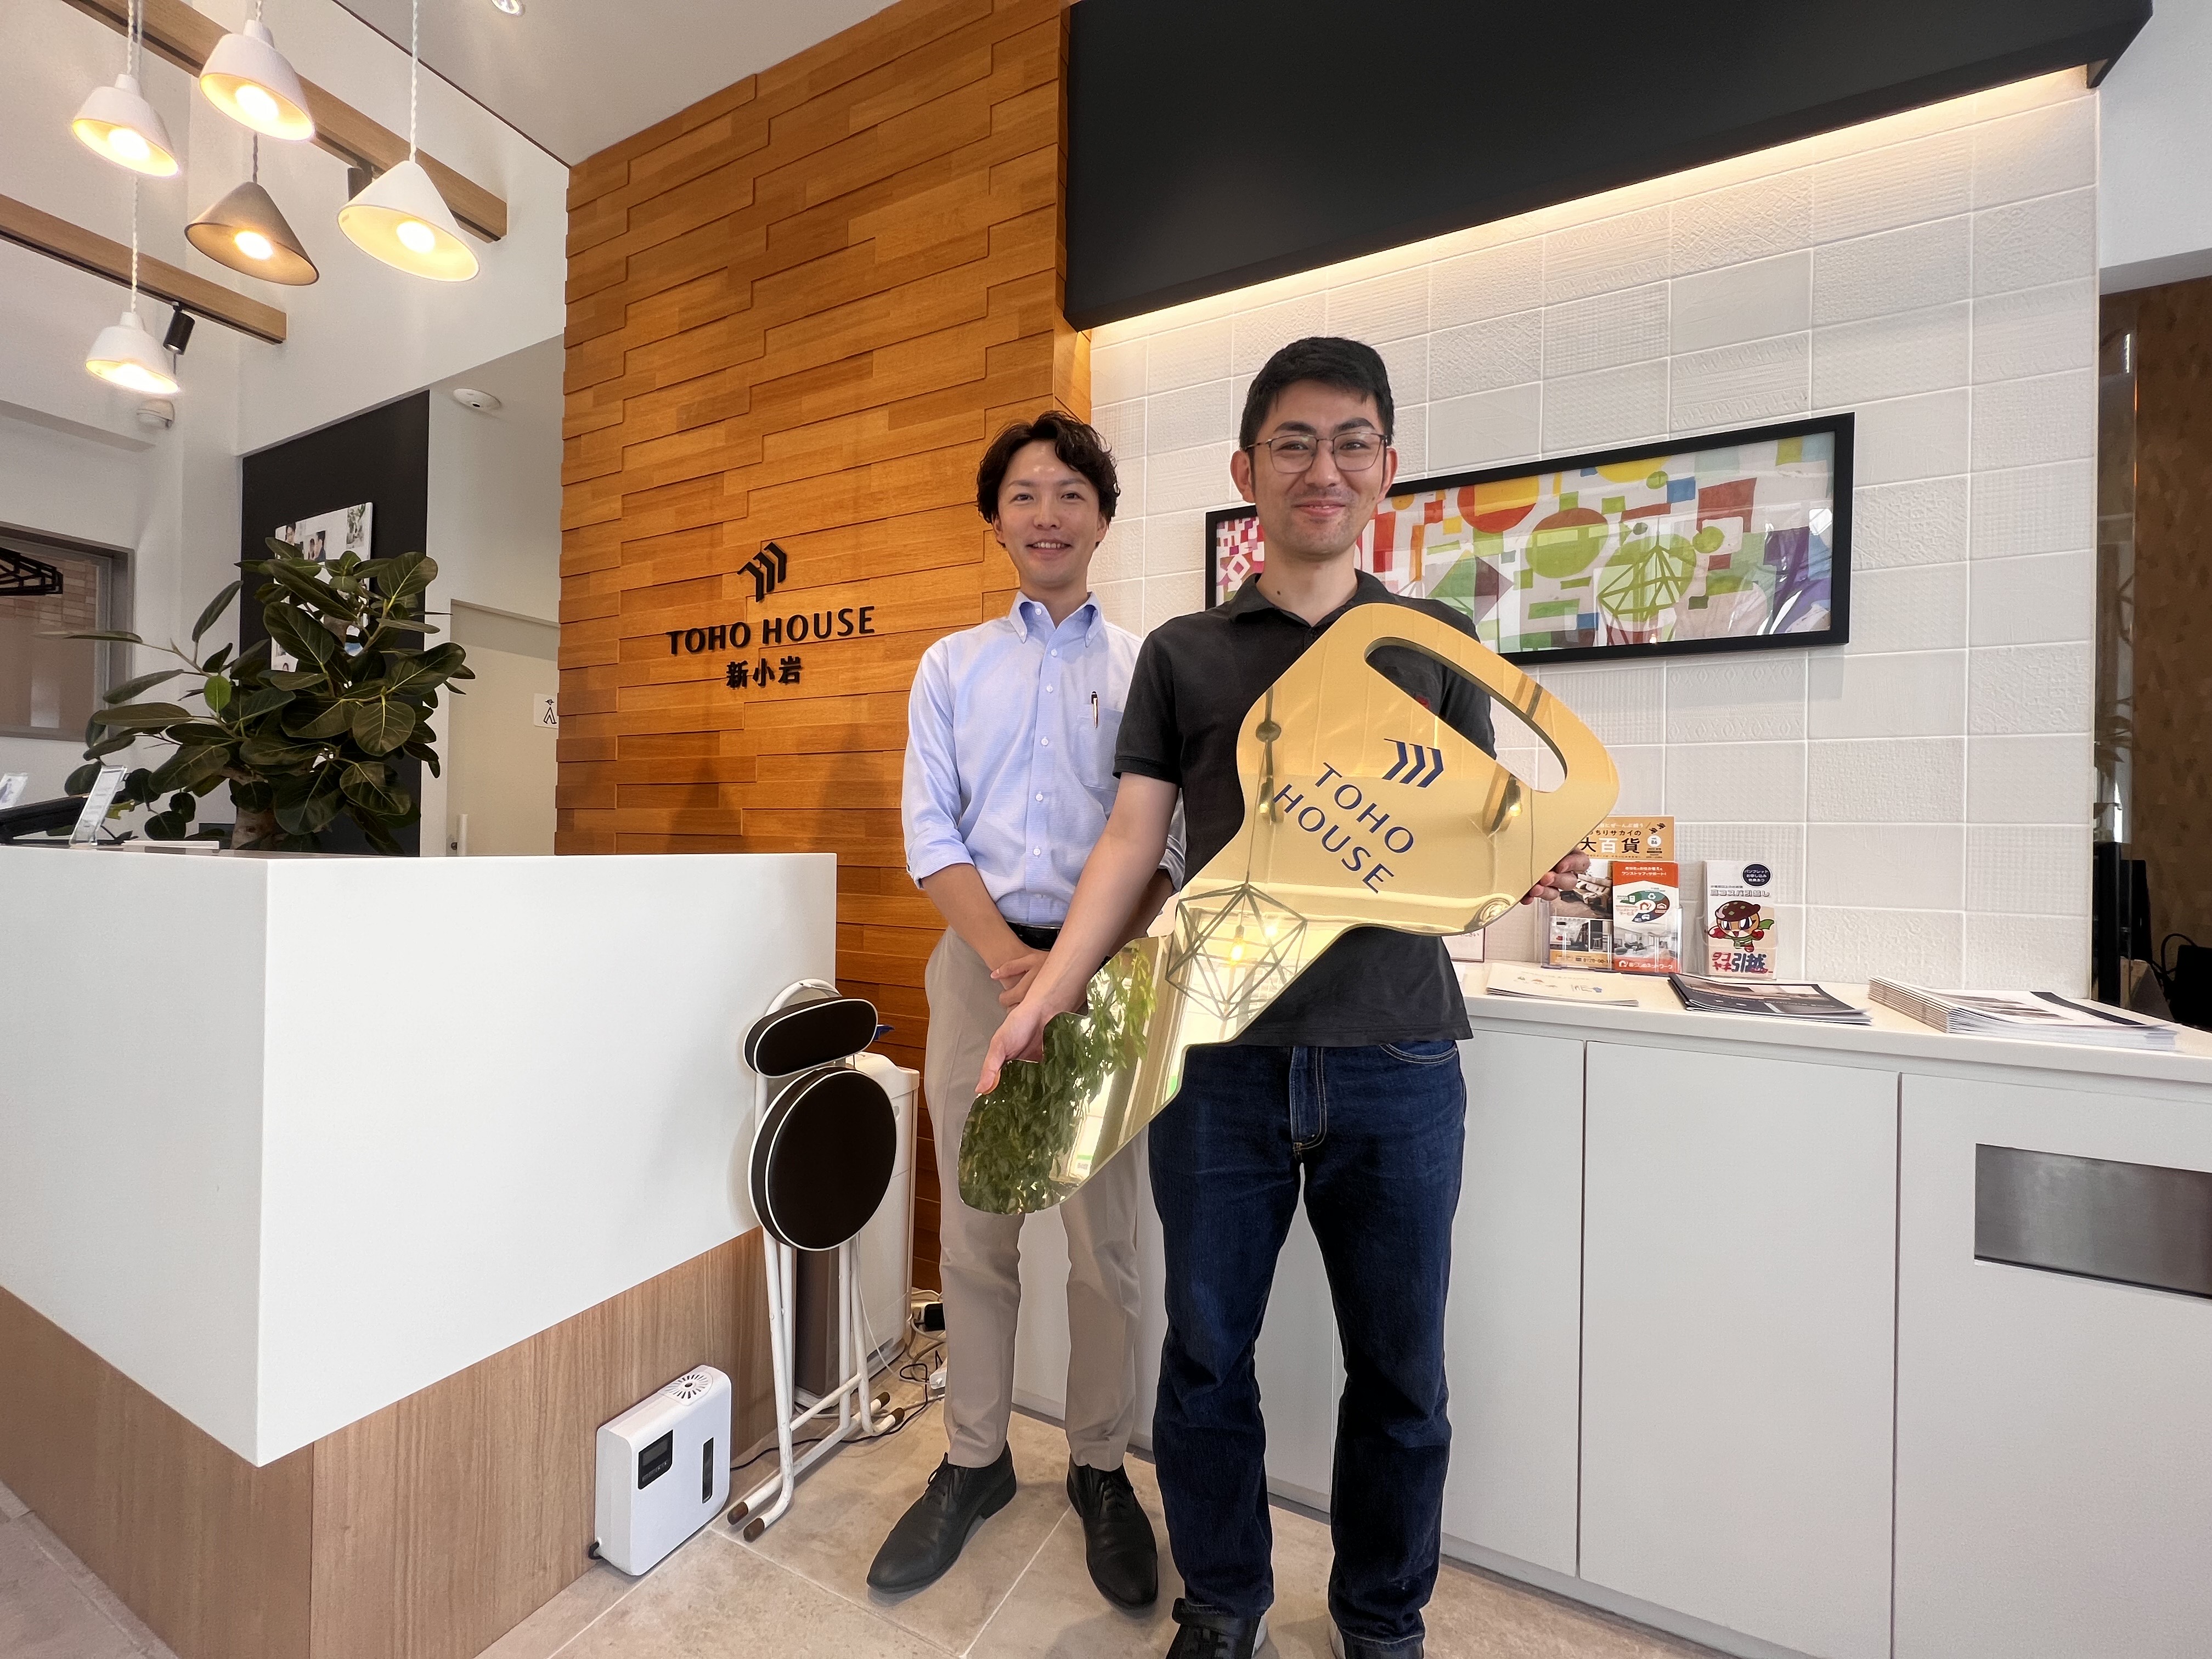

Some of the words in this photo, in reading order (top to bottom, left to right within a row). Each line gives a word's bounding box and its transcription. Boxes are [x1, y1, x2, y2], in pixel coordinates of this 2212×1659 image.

[666, 622, 751, 656] TOHO
[762, 606, 875, 645] HOUSE
[726, 656, 803, 689] 新小岩
[1314, 762, 1414, 854] TOHO
[1273, 783, 1395, 894] HOUSE
[1581, 837, 1640, 854] 大百貨
